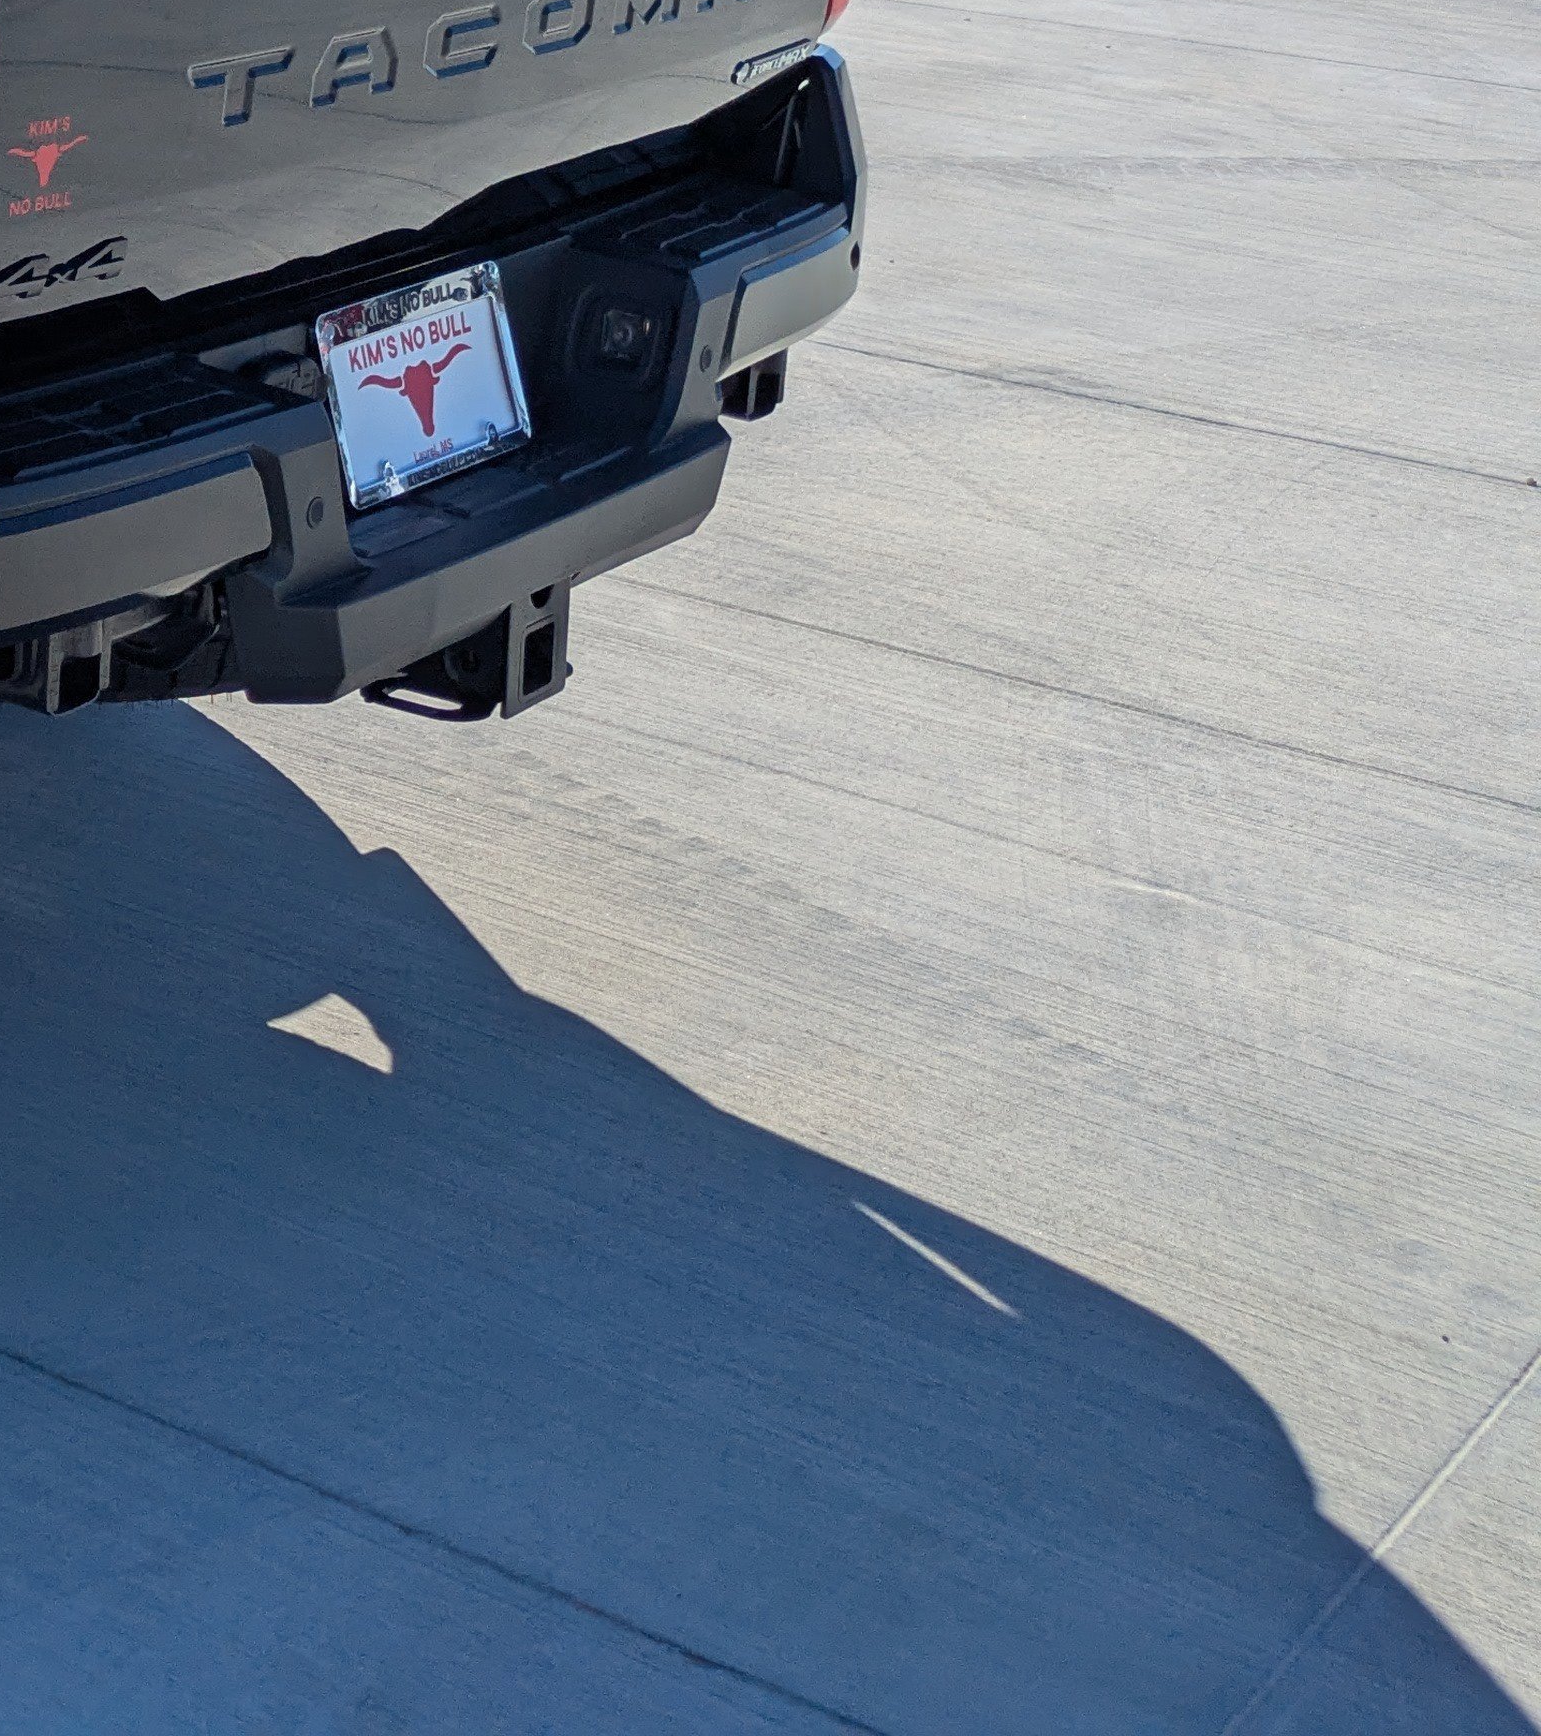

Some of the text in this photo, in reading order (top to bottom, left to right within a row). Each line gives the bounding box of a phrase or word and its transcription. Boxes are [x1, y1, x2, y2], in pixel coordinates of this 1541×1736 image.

[27, 116, 72, 137] KIM'S
[9, 192, 72, 217] NO BULL
[400, 290, 421, 316] NO
[422, 282, 454, 307] BULL
[347, 311, 472, 373] KIM'S NO BULL
